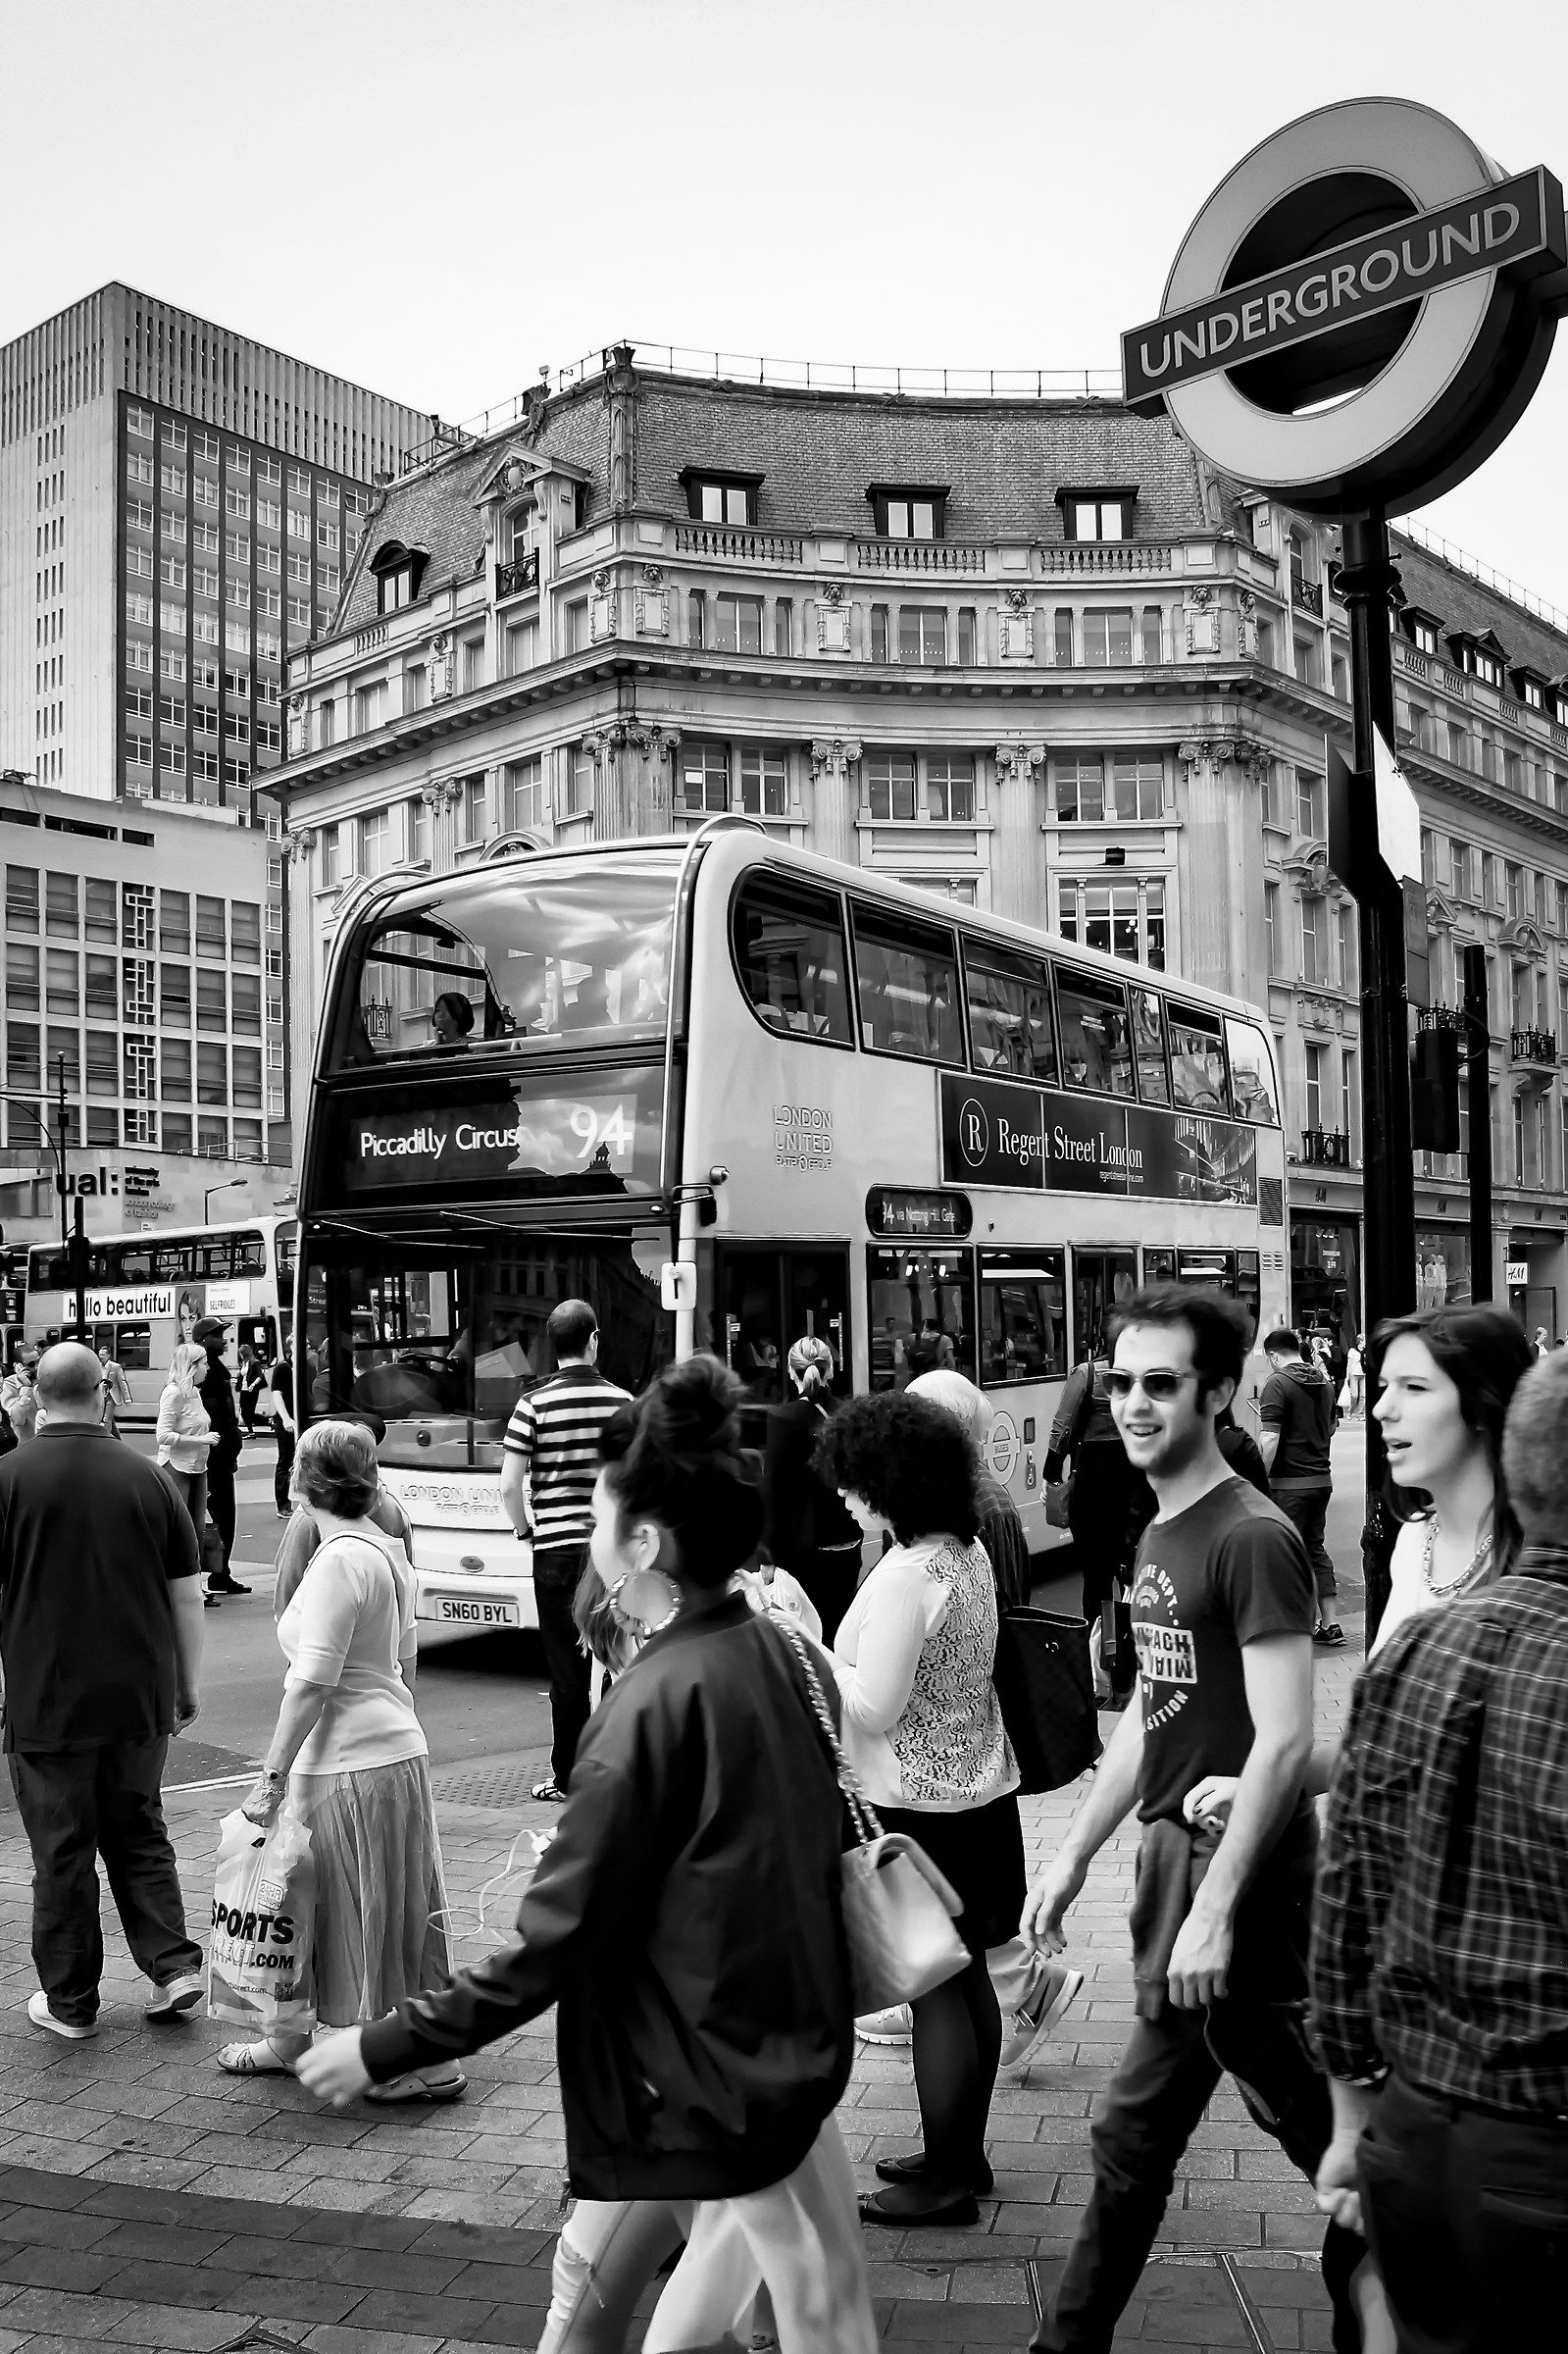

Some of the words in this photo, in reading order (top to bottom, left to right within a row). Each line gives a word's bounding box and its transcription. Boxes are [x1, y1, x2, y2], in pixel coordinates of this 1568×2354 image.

[1140, 202, 1520, 378] UNDERGROUND
[570, 1103, 633, 1158] 94
[774, 1104, 832, 1129] LONDON
[360, 1127, 447, 1159] Piccadilly
[455, 1124, 518, 1151] Circus
[775, 1130, 832, 1154] UNITED
[996, 1117, 1050, 1165] Regent
[1054, 1125, 1096, 1163] Street
[1098, 1131, 1143, 1168] London
[69, 1297, 101, 1318] hllo
[107, 1292, 171, 1315] beautiful
[400, 1485, 463, 1502] LONDON
[442, 1602, 480, 1620] SN60
[483, 1605, 512, 1623] BYL
[211, 1898, 295, 1945] SPORTS
